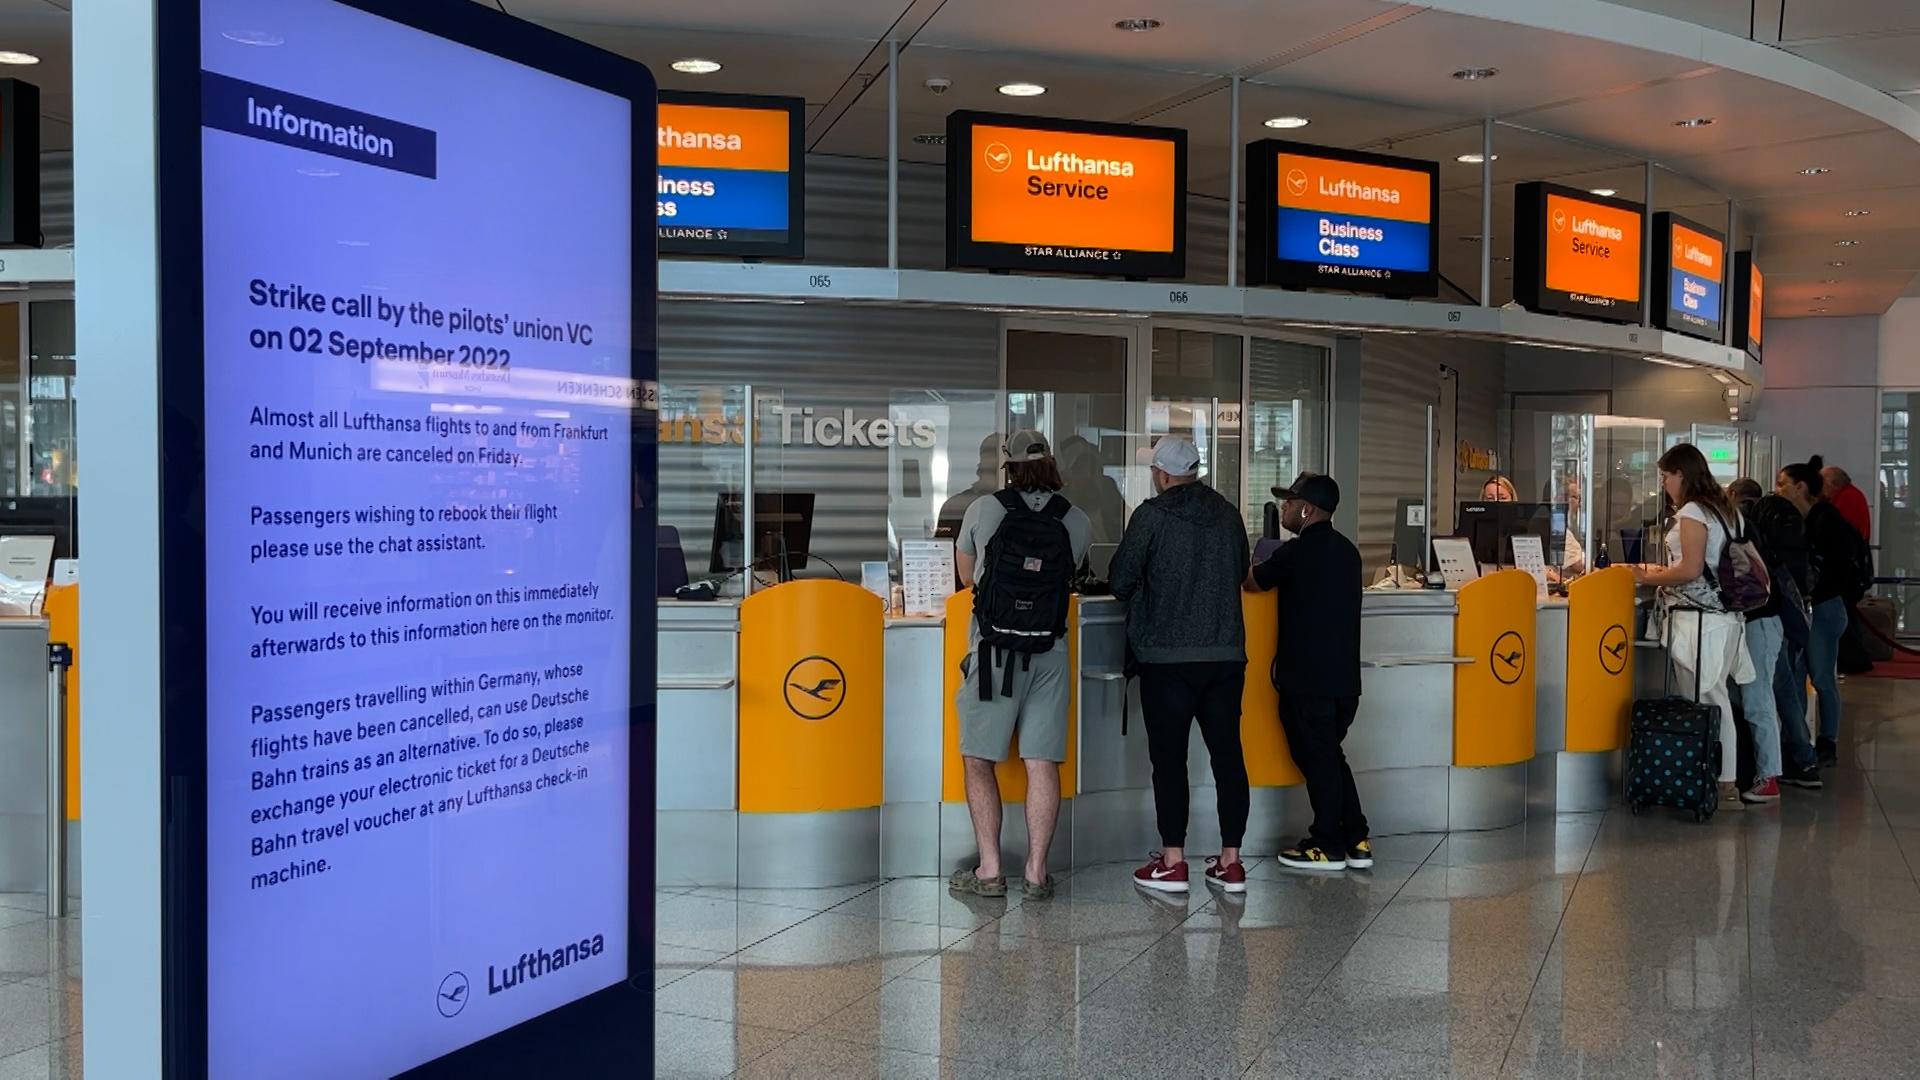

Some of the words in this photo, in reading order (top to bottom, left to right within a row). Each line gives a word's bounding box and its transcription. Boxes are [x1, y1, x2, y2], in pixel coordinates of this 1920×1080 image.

[247, 98, 394, 158] Information
[658, 125, 742, 151] thansa
[1027, 149, 1134, 177] Lufthansa
[658, 175, 715, 196] iness
[1027, 175, 1109, 200] Service
[1319, 175, 1400, 204] Lufthansa
[659, 227, 713, 240] LLIANCE
[1319, 218, 1383, 242] Business
[1572, 215, 1622, 241] Lufthansa
[1025, 246, 1053, 256] STAR
[1055, 249, 1109, 260] ALLIANCE
[1318, 238, 1360, 258] Class
[1572, 236, 1611, 259] Service
[808, 273, 832, 289] 065
[1318, 264, 1340, 275] STAR
[1341, 267, 1382, 279] ALLIANCE
[248, 278, 327, 314] Strike
[331, 293, 372, 319] call
[377, 295, 406, 329] by
[408, 301, 445, 329] the
[512, 317, 564, 342] union
[566, 321, 593, 346] VC
[1169, 291, 1189, 304] 066
[249, 328, 283, 350] on
[288, 325, 323, 354] 02
[327, 330, 456, 366] September
[458, 344, 511, 371] 2022
[249, 405, 315, 429] Almost
[318, 409, 339, 429] all
[343, 410, 422, 433] Lufthansa
[425, 415, 472, 439] flights
[473, 419, 490, 437] to
[492, 421, 518, 437] and
[519, 421, 551, 438] from
[553, 422, 609, 441] Frankfurt
[772, 406, 937, 449] Tickets
[249, 439, 284, 460] and
[289, 441, 353, 461] Munich
[356, 447, 382, 462] are
[385, 445, 454, 464] canceled
[456, 450, 475, 465] on
[478, 446, 524, 469] Friday.
[251, 506, 351, 529] Passengers
[354, 505, 415, 527] wishing
[418, 506, 435, 523] to
[438, 503, 488, 522] rebook
[489, 503, 521, 521] their
[524, 503, 558, 525] flight
[250, 539, 310, 564] please
[313, 541, 344, 557] use
[347, 537, 375, 555] the
[378, 535, 413, 554] chat
[416, 533, 486, 553] assistant.
[250, 605, 284, 625] You
[288, 601, 318, 622] will
[323, 597, 383, 619] receive
[386, 591, 472, 614] information
[474, 592, 493, 607] on
[495, 587, 521, 605] this
[523, 581, 600, 602] immediately
[250, 631, 346, 659] afterwards
[348, 631, 367, 648] to
[369, 625, 400, 646] this
[403, 621, 488, 642] information
[490, 617, 520, 632] here
[522, 616, 540, 630] on
[541, 611, 563, 627] the
[565, 607, 614, 625] monitor.
[251, 697, 352, 725] Passengers
[354, 685, 427, 709] travelling
[430, 677, 475, 698] within
[478, 671, 541, 691] Germany,
[543, 663, 584, 680] whose
[250, 733, 309, 760] flights
[313, 728, 353, 748] have
[357, 721, 396, 740] been
[399, 704, 474, 733] cancelled,
[476, 703, 502, 720] can
[504, 698, 529, 715] use
[531, 687, 590, 711] Deutsche
[251, 767, 297, 791] Bahn
[301, 758, 350, 781] trains
[353, 754, 372, 772] as
[375, 751, 395, 768] an
[398, 735, 481, 763] alternative.
[483, 728, 500, 746] To
[502, 725, 520, 743] do
[522, 724, 542, 740] so,
[544, 716, 584, 739] please
[250, 793, 336, 825] exchange
[339, 785, 376, 810] your
[378, 766, 454, 797] electronic
[456, 757, 497, 780] ticket
[498, 753, 519, 771] for
[520, 753, 529, 767] a
[531, 739, 590, 765] Deutsche
[251, 832, 297, 857] Bahn
[301, 817, 350, 845] travel
[353, 806, 417, 832] voucher
[419, 799, 435, 818] at
[437, 795, 464, 814] any
[466, 779, 533, 807] Lufthansa
[535, 765, 588, 790] check-in
[251, 858, 332, 890] machine.
[488, 933, 605, 996] Lufthansa
